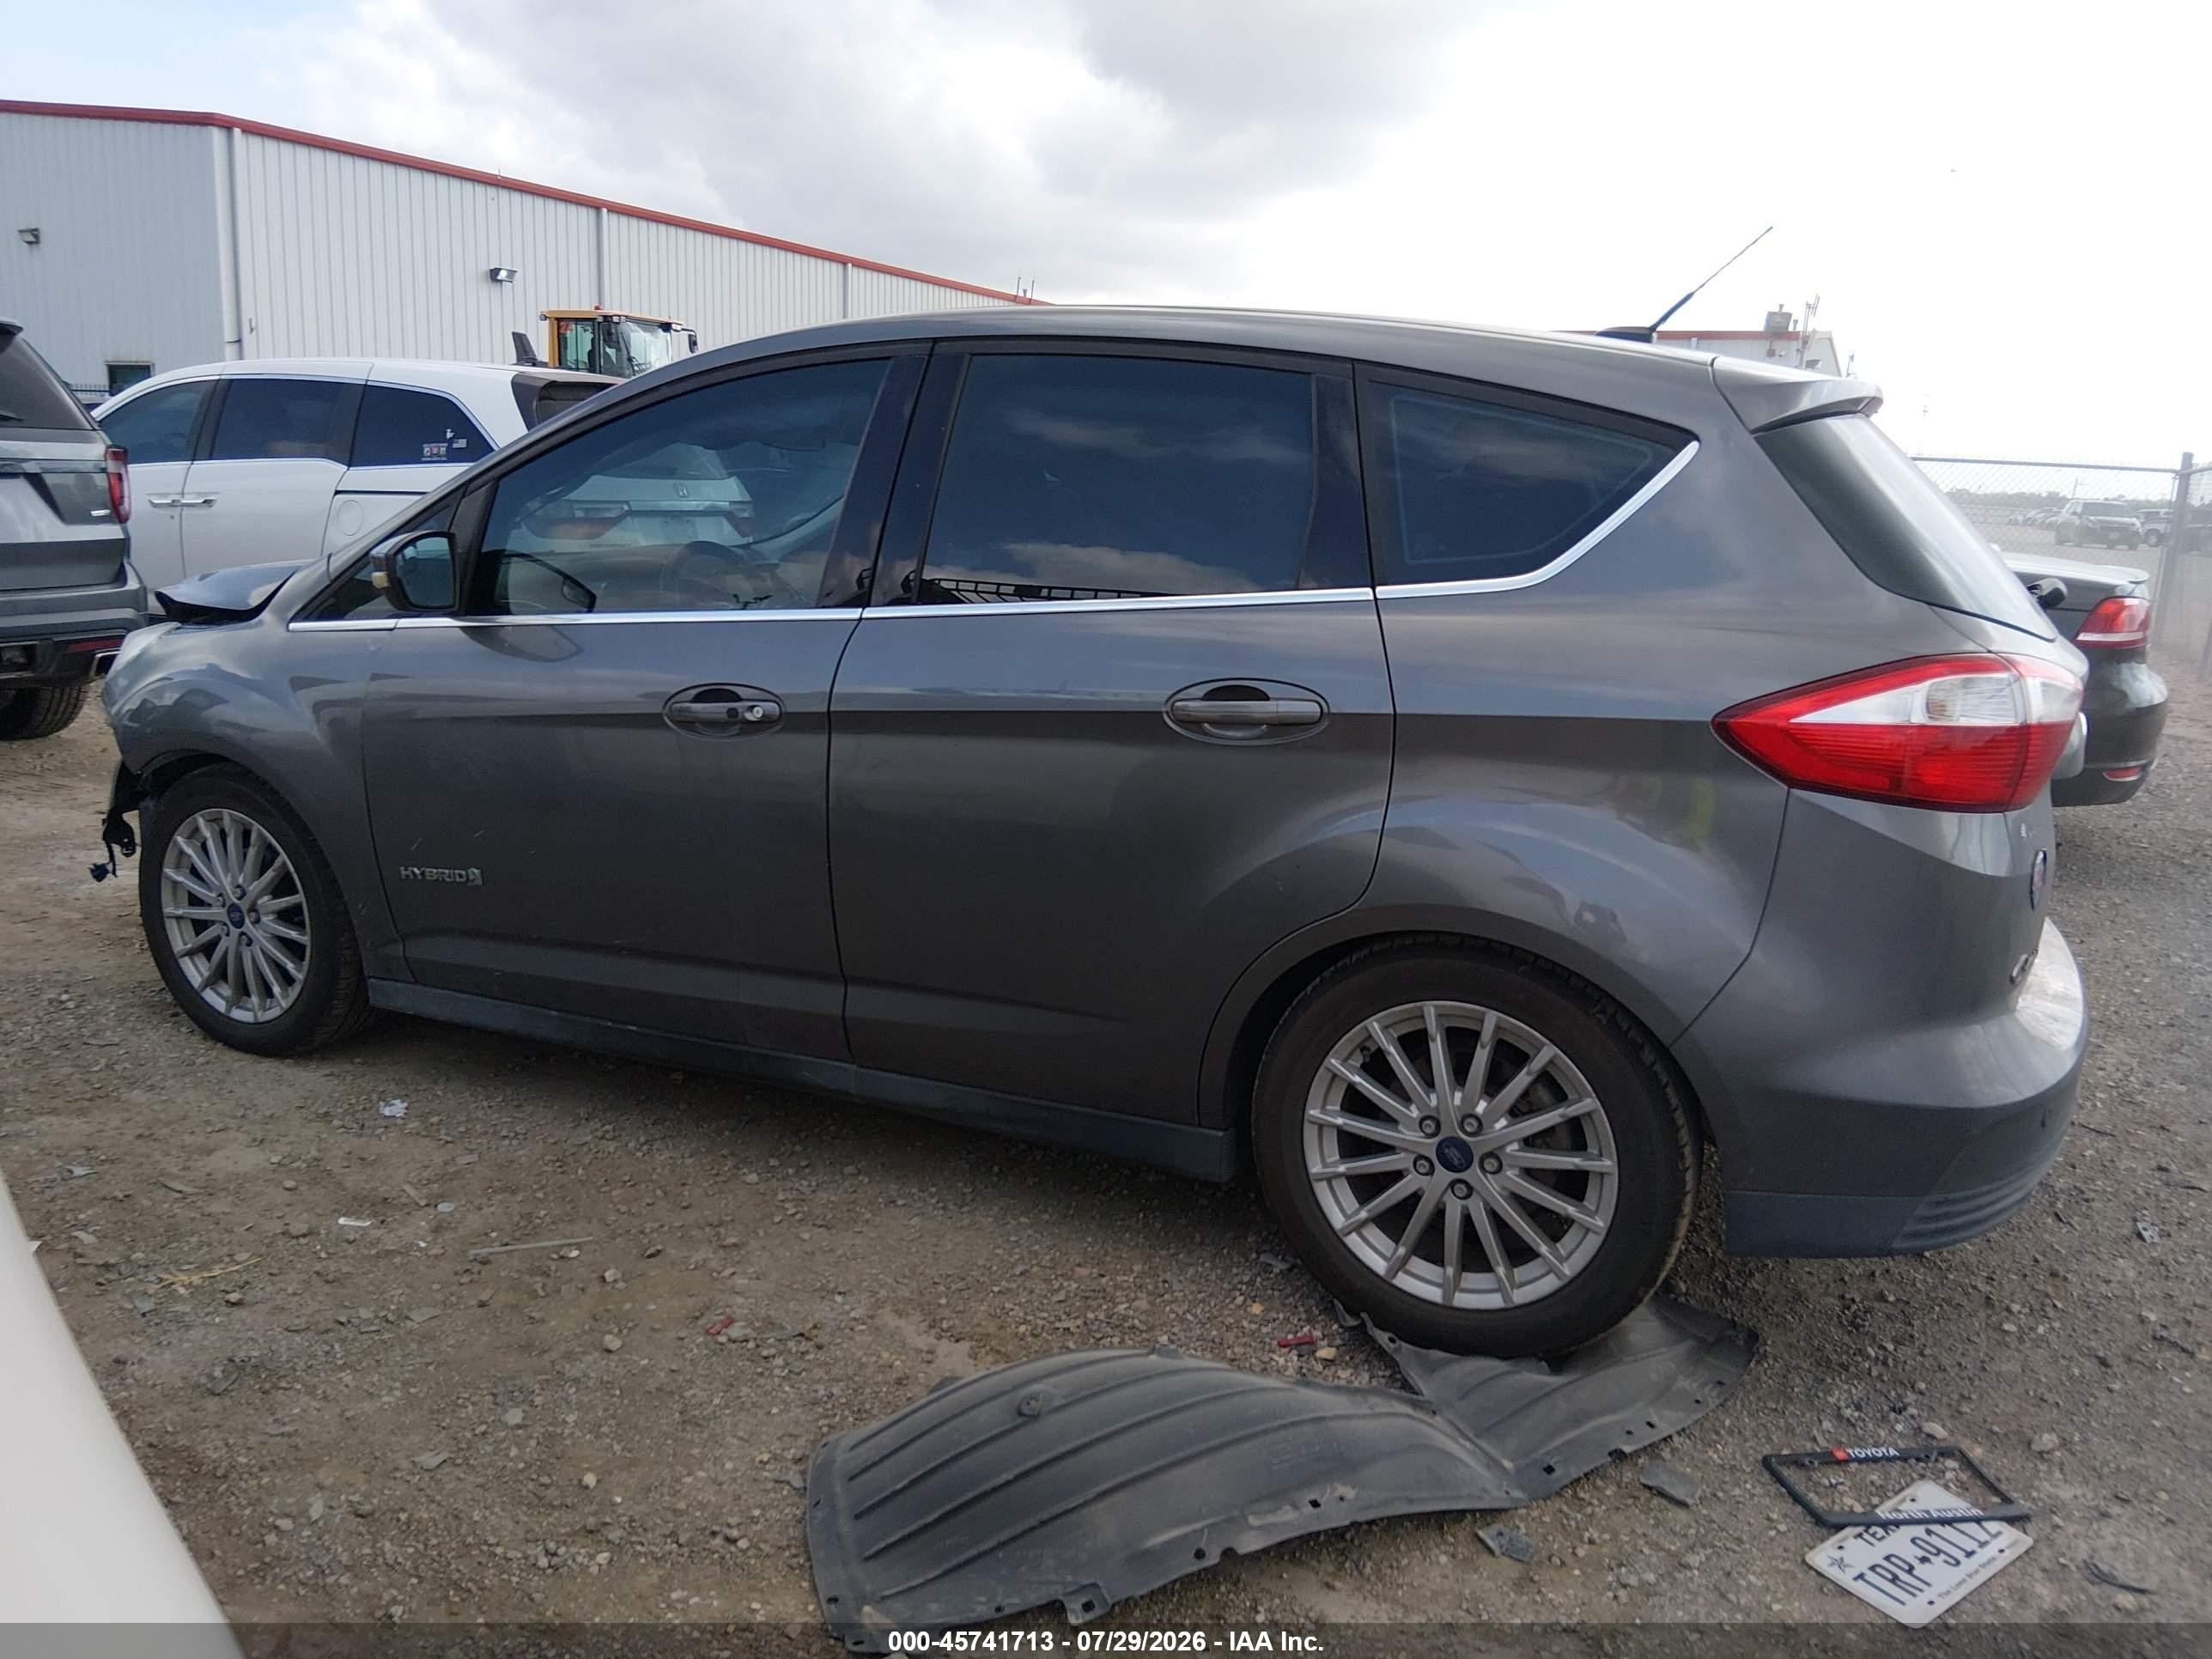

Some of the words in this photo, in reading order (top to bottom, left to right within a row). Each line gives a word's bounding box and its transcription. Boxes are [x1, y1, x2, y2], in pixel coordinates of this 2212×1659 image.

[398, 866, 467, 883] HYBRID
[1846, 1447, 1900, 1459] TOYOTA
[1875, 1510, 1928, 1520] North
[1931, 1505, 1985, 1517] Austin
[1852, 1553, 1933, 1607] TRP
